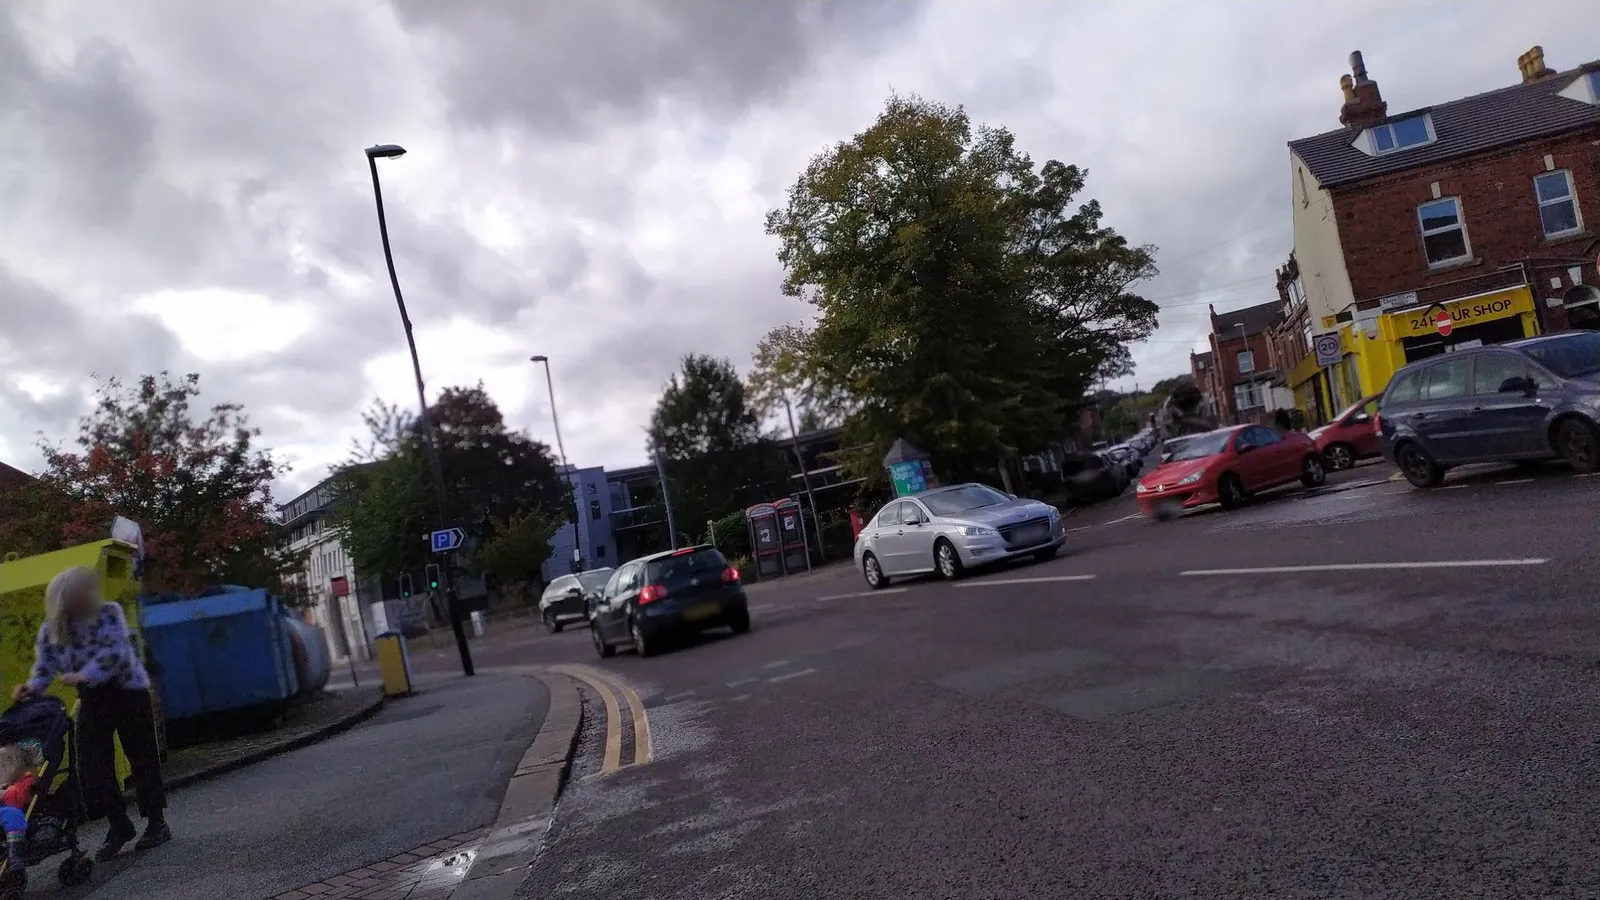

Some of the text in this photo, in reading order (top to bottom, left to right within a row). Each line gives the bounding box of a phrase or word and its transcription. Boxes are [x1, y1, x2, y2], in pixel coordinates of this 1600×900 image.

[1411, 317, 1428, 330] 24
[1429, 308, 1471, 326] HUR
[1474, 299, 1512, 317] SHOP
[1321, 342, 1336, 351] 20
[438, 534, 448, 547] P
